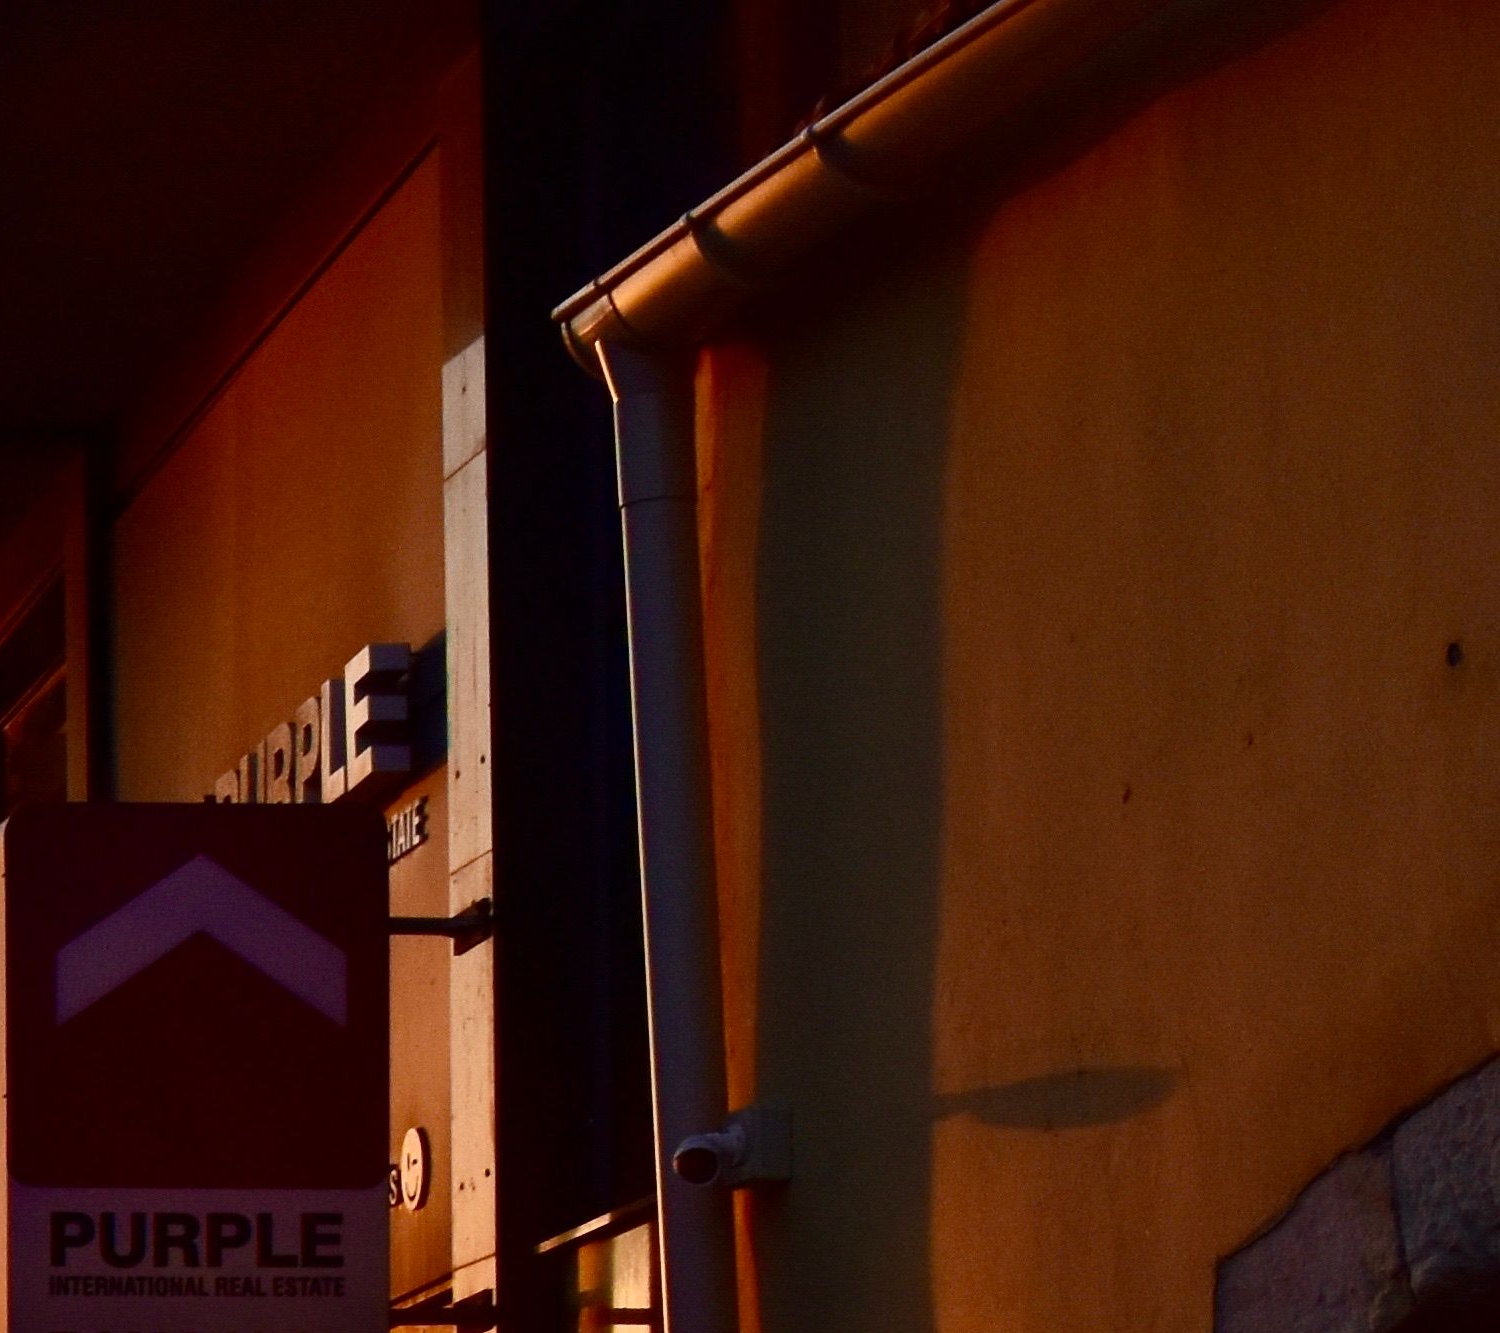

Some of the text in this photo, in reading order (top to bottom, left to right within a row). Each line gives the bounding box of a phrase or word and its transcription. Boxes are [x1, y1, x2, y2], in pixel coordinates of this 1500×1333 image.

[50, 1211, 345, 1268] PURPLE
[49, 1276, 346, 1297] INTERNATIONAL REAL ESTATE
